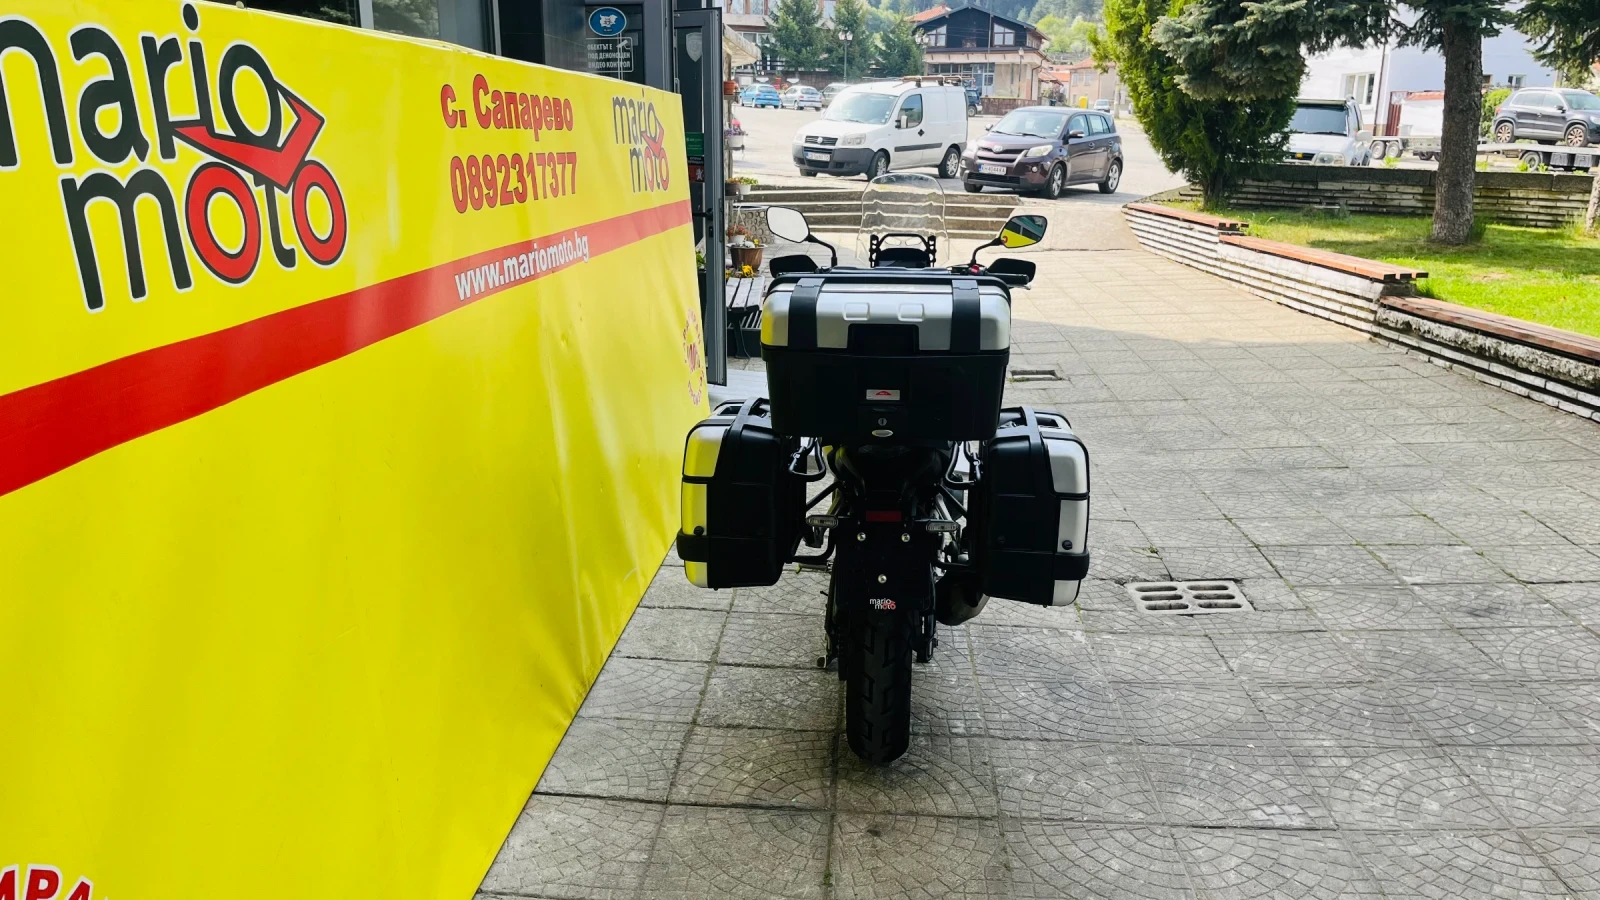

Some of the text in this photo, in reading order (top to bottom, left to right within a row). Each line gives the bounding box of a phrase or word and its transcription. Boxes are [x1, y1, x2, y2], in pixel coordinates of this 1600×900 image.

[441, 73, 574, 141] с. Сапарево
[612, 87, 659, 145] mario
[450, 152, 577, 214] 0892317377
[629, 145, 669, 193] moto
[60, 161, 348, 310] moto
[454, 230, 589, 301] www.mariomoto.bg
[869, 597, 892, 605] mario
[874, 602, 897, 610] moto
